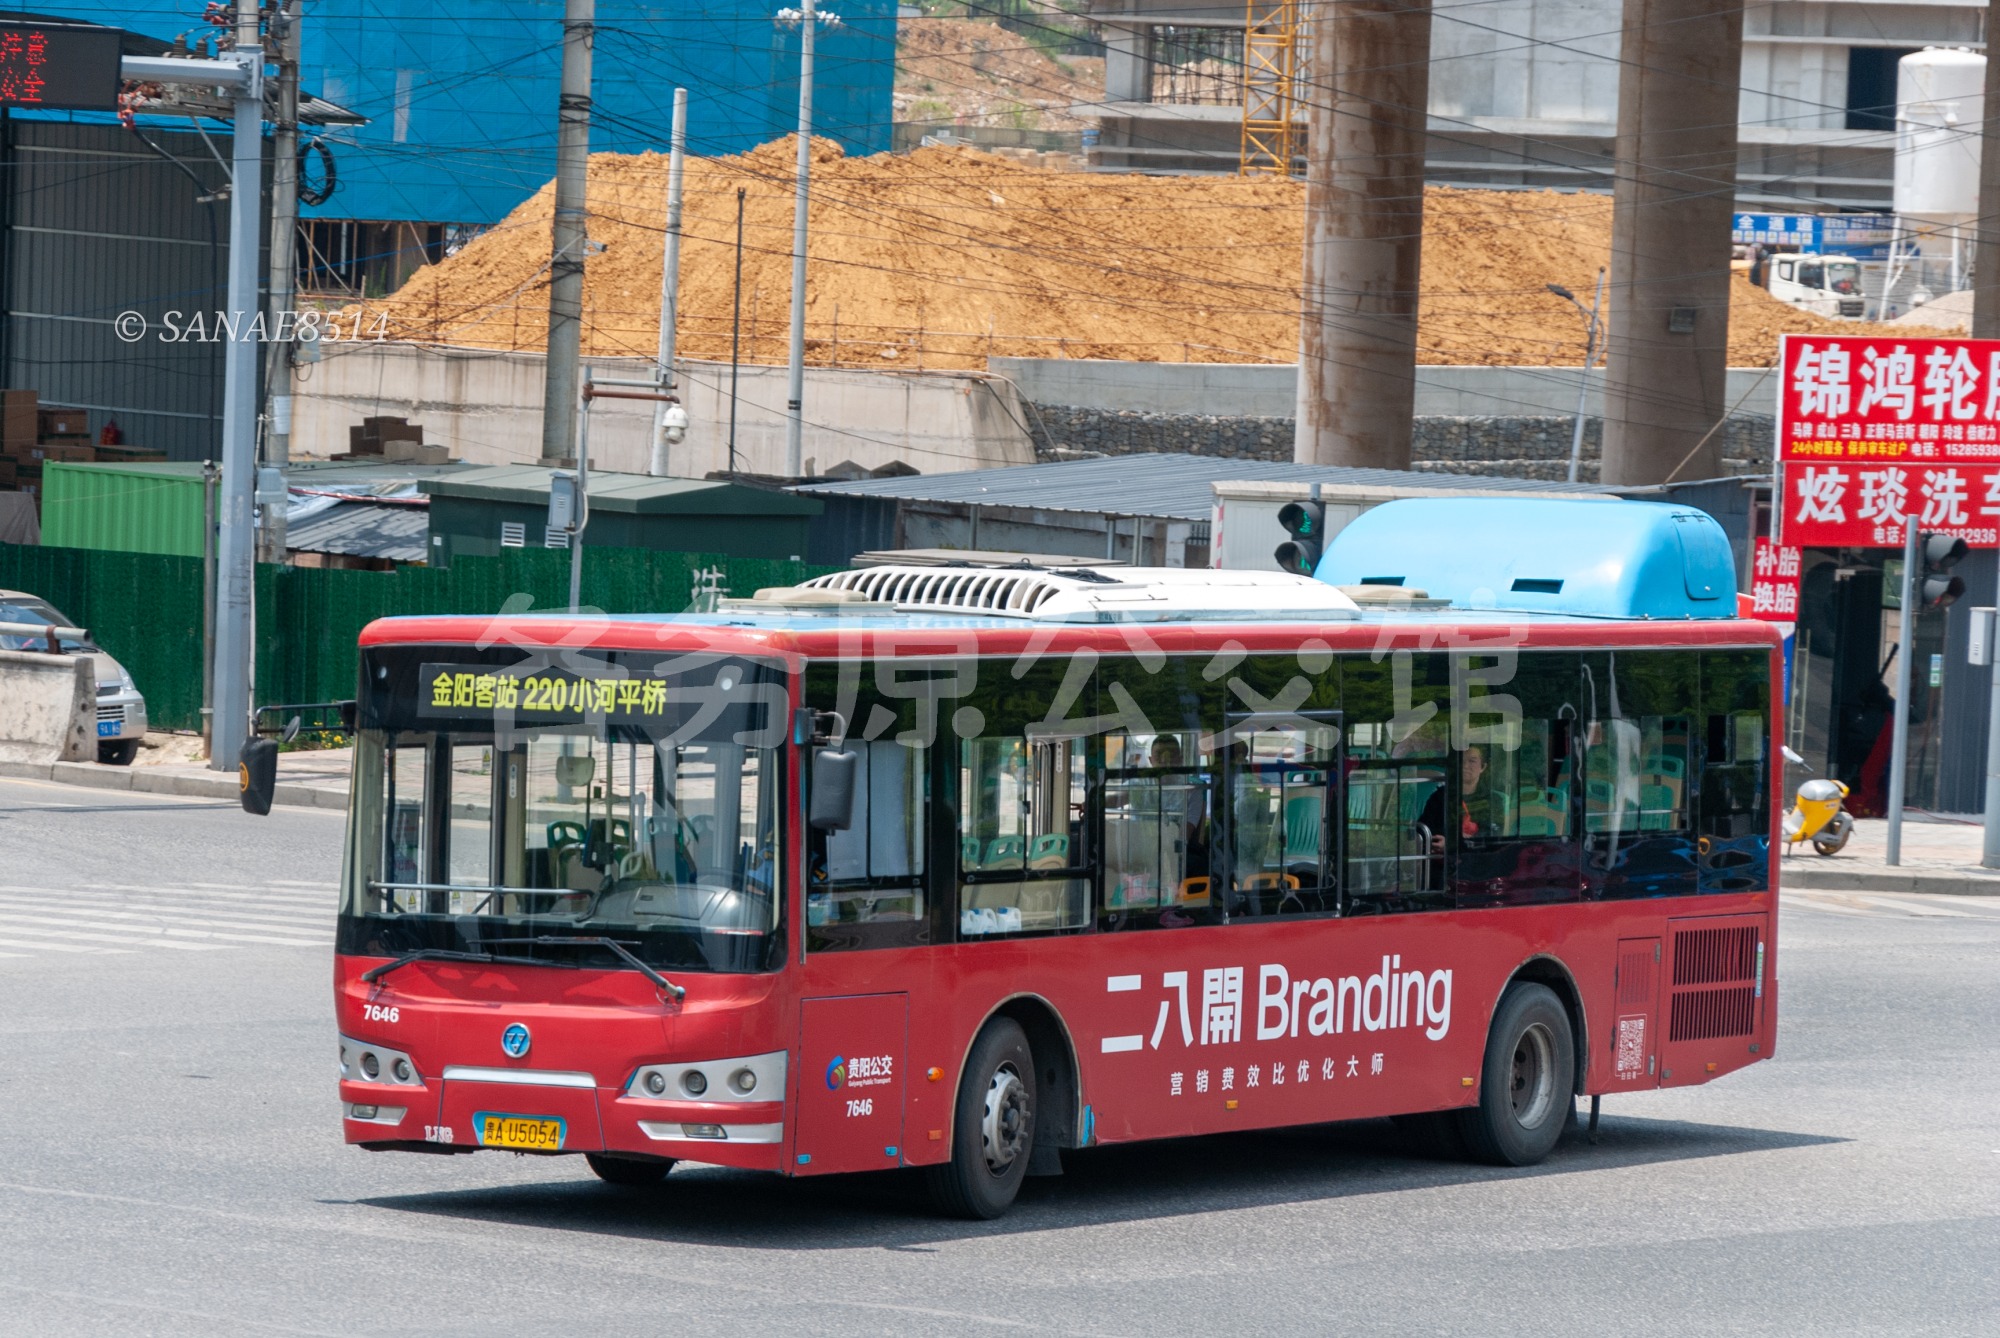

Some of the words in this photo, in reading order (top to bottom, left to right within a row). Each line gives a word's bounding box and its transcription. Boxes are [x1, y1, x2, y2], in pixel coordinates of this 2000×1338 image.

[1840, 422, 1861, 439] 三角
[1792, 440, 1844, 455] 24小时服务
[1756, 545, 1800, 577] 补胎
[1753, 582, 1797, 613] 换胎
[432, 672, 520, 709] 金阳客站
[522, 676, 567, 712] 220
[569, 677, 667, 715] 小河平桥
[1257, 954, 1453, 1041] Branding
[363, 1004, 399, 1023] 7646
[848, 1054, 893, 1079] 贵阳公交
[1170, 1053, 1384, 1096] 营销费效比优化大师
[846, 1098, 873, 1117] 7646
[425, 1126, 453, 1143] LNG
